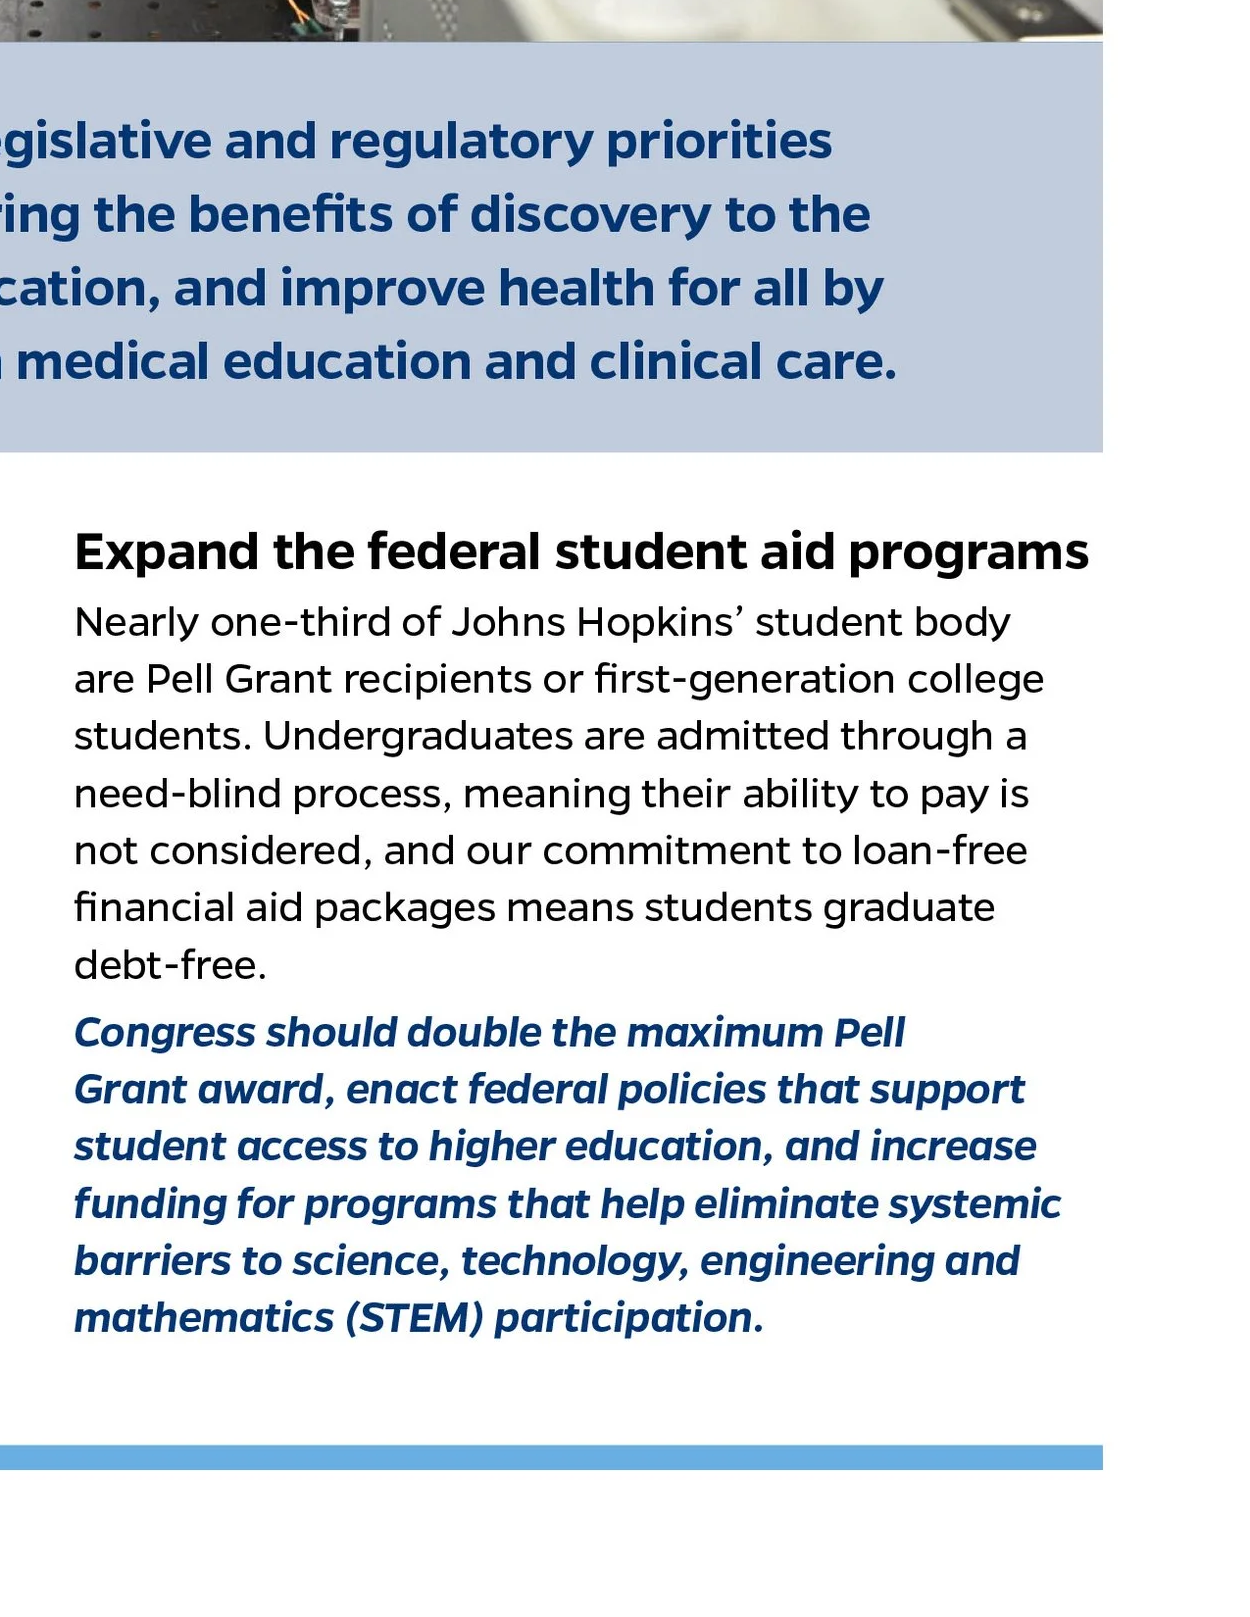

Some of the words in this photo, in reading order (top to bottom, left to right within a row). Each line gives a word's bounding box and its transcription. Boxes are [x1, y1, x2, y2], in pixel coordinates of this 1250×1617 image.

[225, 120, 316, 159] and
[331, 120, 595, 169] regulatory
[608, 118, 833, 168] priorities
[93, 193, 176, 233] the
[190, 191, 393, 233] benefits
[407, 192, 459, 233] of
[470, 191, 713, 242] discovery
[724, 197, 776, 233] to
[788, 193, 871, 233] the
[174, 267, 266, 307] and
[281, 265, 485, 315] improve
[500, 267, 654, 307] health
[668, 265, 742, 307] for
[754, 267, 808, 307] all
[824, 267, 885, 315] by
[17, 338, 208, 380] medical
[223, 338, 471, 380] education
[485, 340, 576, 380] and
[590, 338, 761, 380] clinical
[776, 349, 896, 380] care.
[76, 531, 258, 579] Expand
[272, 531, 355, 570] the
[367, 529, 539, 570] federal
[555, 531, 749, 570] student
[760, 528, 835, 570] aid
[850, 539, 1089, 580] programs
[76, 605, 200, 643] Nearly
[211, 605, 390, 637] one-third
[402, 604, 443, 637] of
[451, 605, 566, 637] Johns
[578, 604, 743, 644] Hopkins’
[755, 605, 903, 637] student
[915, 605, 1012, 643] body
[74, 719, 251, 751] students.
[264, 719, 574, 758] Undergraduates
[584, 727, 645, 751] are
[657, 719, 829, 751] admitted
[840, 719, 992, 758] through
[1006, 727, 1027, 751] a
[75, 837, 139, 865] not
[150, 834, 372, 871] considered,
[384, 834, 454, 865] and
[466, 841, 533, 865] our
[543, 834, 792, 865] commitment
[801, 837, 842, 865] to
[854, 833, 1028, 865] loan-free
[74, 947, 266, 980] debt-free.
[74, 1016, 257, 1055] Congress
[265, 1015, 399, 1048] should
[407, 1015, 542, 1048] double
[551, 1015, 617, 1048] the
[626, 1013, 824, 1048] maximum
[834, 1015, 907, 1048] Pell
[74, 1073, 189, 1105] Grant
[197, 1072, 335, 1110] award,
[346, 1075, 459, 1105] enact
[468, 1071, 610, 1105] federal
[617, 1070, 767, 1111] policies
[777, 1072, 861, 1105] that
[869, 1075, 1027, 1111] support
[74, 1185, 228, 1226] funding
[236, 1186, 296, 1219] for
[303, 1194, 498, 1226] programs
[507, 1186, 591, 1219] that
[600, 1187, 686, 1226] help
[694, 1185, 880, 1219] eliminate
[887, 1185, 1063, 1225] systemic
[73, 1242, 232, 1276] barriers
[241, 1246, 283, 1276] to
[291, 1242, 449, 1282] science,
[461, 1243, 688, 1283] technology,
[700, 1242, 936, 1283] engineering
[945, 1243, 1022, 1276] and
